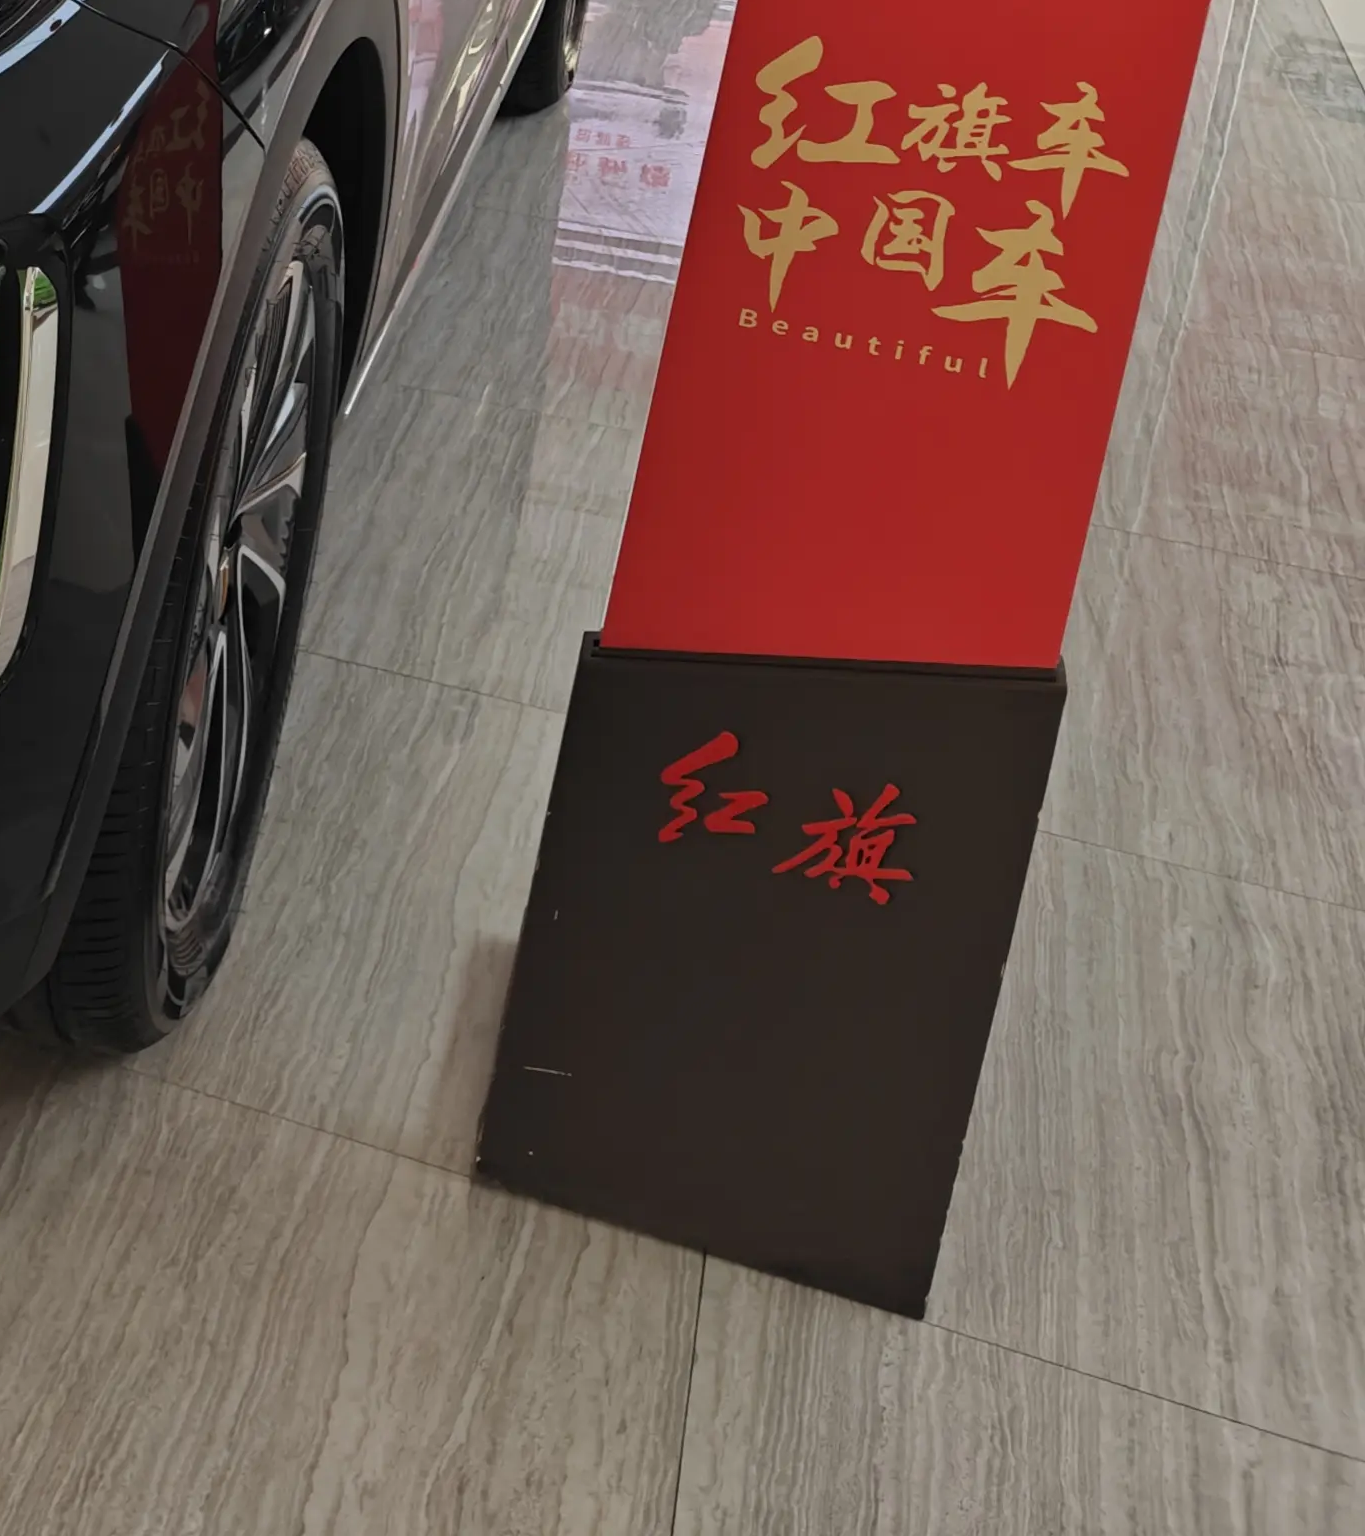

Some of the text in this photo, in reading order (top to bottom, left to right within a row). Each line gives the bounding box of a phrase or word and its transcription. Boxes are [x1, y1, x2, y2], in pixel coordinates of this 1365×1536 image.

[751, 35, 1130, 220] 红旗车
[736, 181, 1098, 390] 中国车
[738, 308, 989, 380] Beautiful
[657, 731, 918, 905] 红旗
